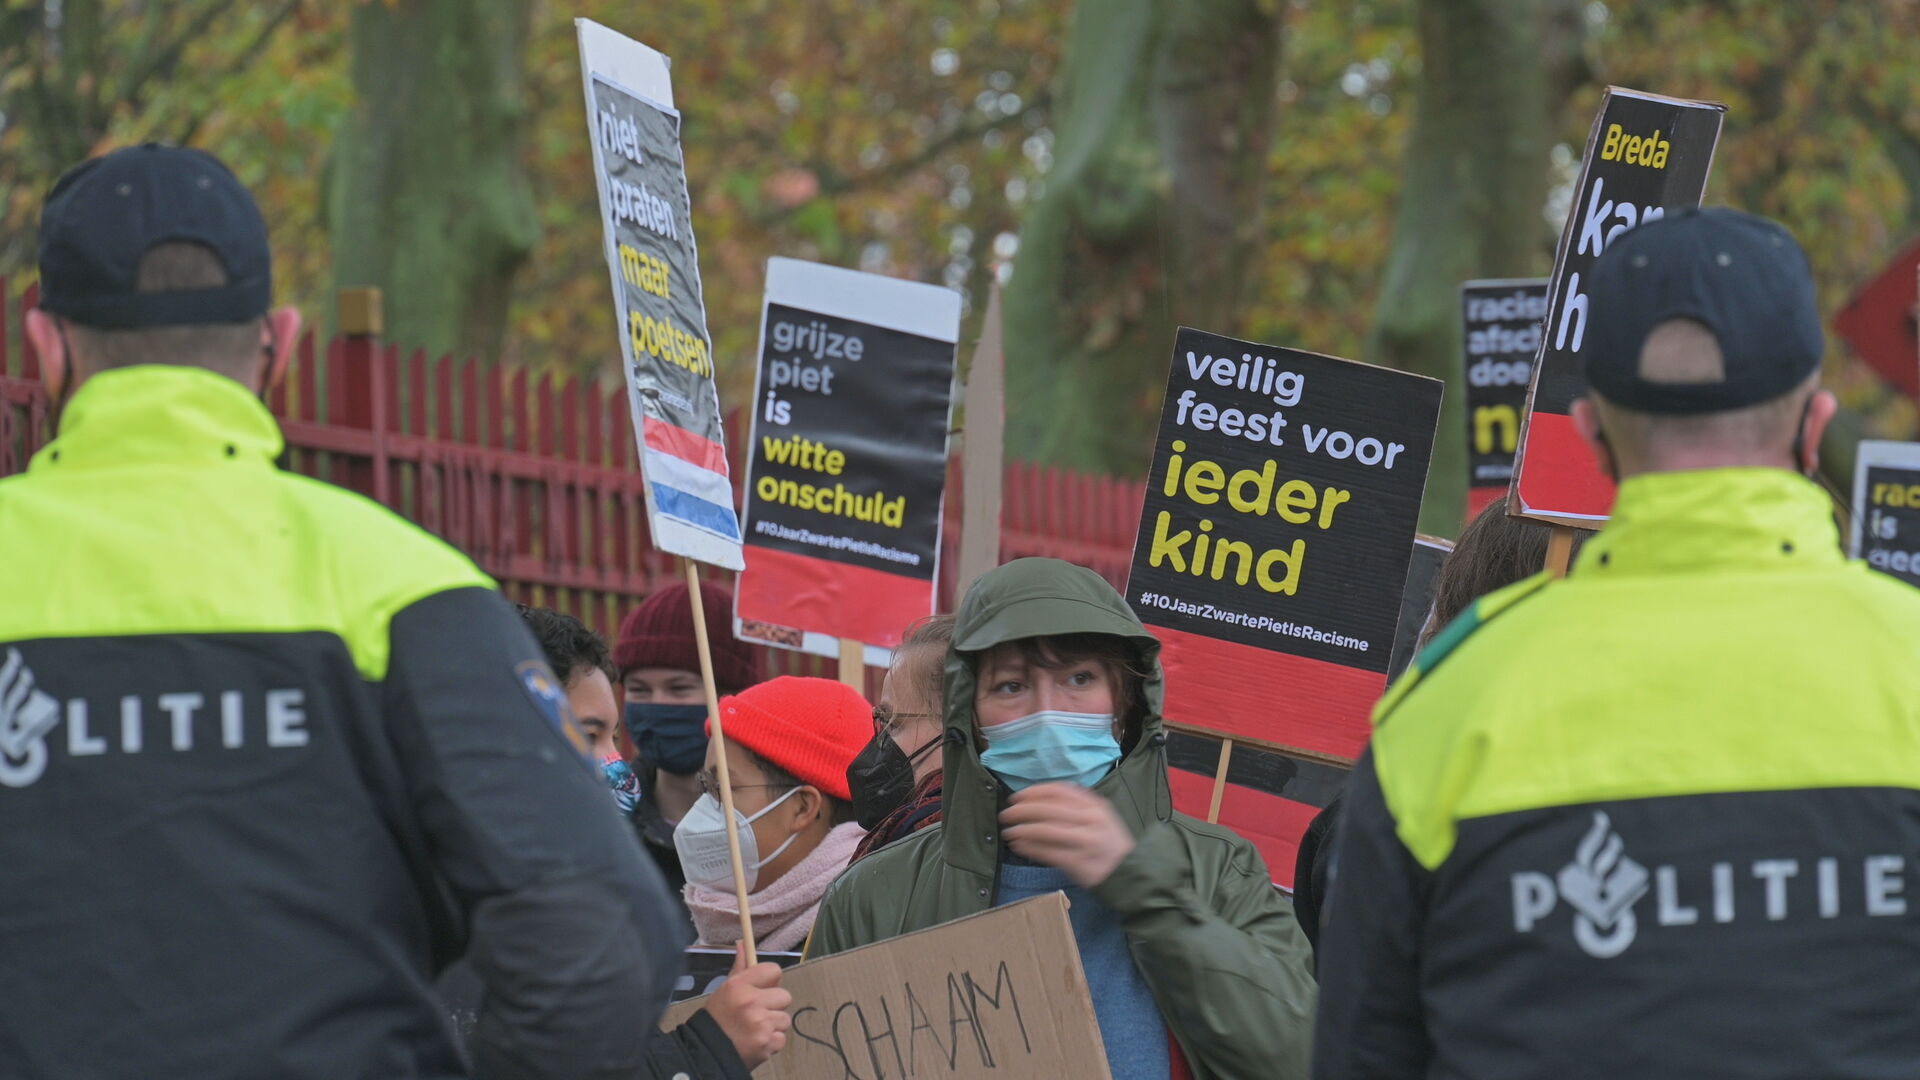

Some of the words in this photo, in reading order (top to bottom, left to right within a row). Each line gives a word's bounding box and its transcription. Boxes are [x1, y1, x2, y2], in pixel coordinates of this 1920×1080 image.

[601, 102, 643, 165] niet
[1601, 123, 1670, 169] Breda
[610, 175, 678, 241] praten
[620, 243, 672, 300] maar
[630, 310, 710, 379] poetsen
[773, 320, 865, 361] grijze
[769, 357, 835, 395] piet
[1186, 351, 1305, 407] veilig
[764, 390, 792, 426] is
[1176, 390, 1288, 446] feest
[1302, 424, 1405, 470] voor
[763, 434, 846, 476] witte
[757, 475, 906, 529] onschuld
[1163, 440, 1351, 530] ieder
[755, 519, 921, 566] #10JaarZwartePietIsRacisme
[1870, 508, 1898, 540] is
[1149, 510, 1306, 596] kind
[1140, 592, 1370, 652] #10JaarZwartePietIsRacisme
[791, 960, 1032, 1080] SCHAAM
